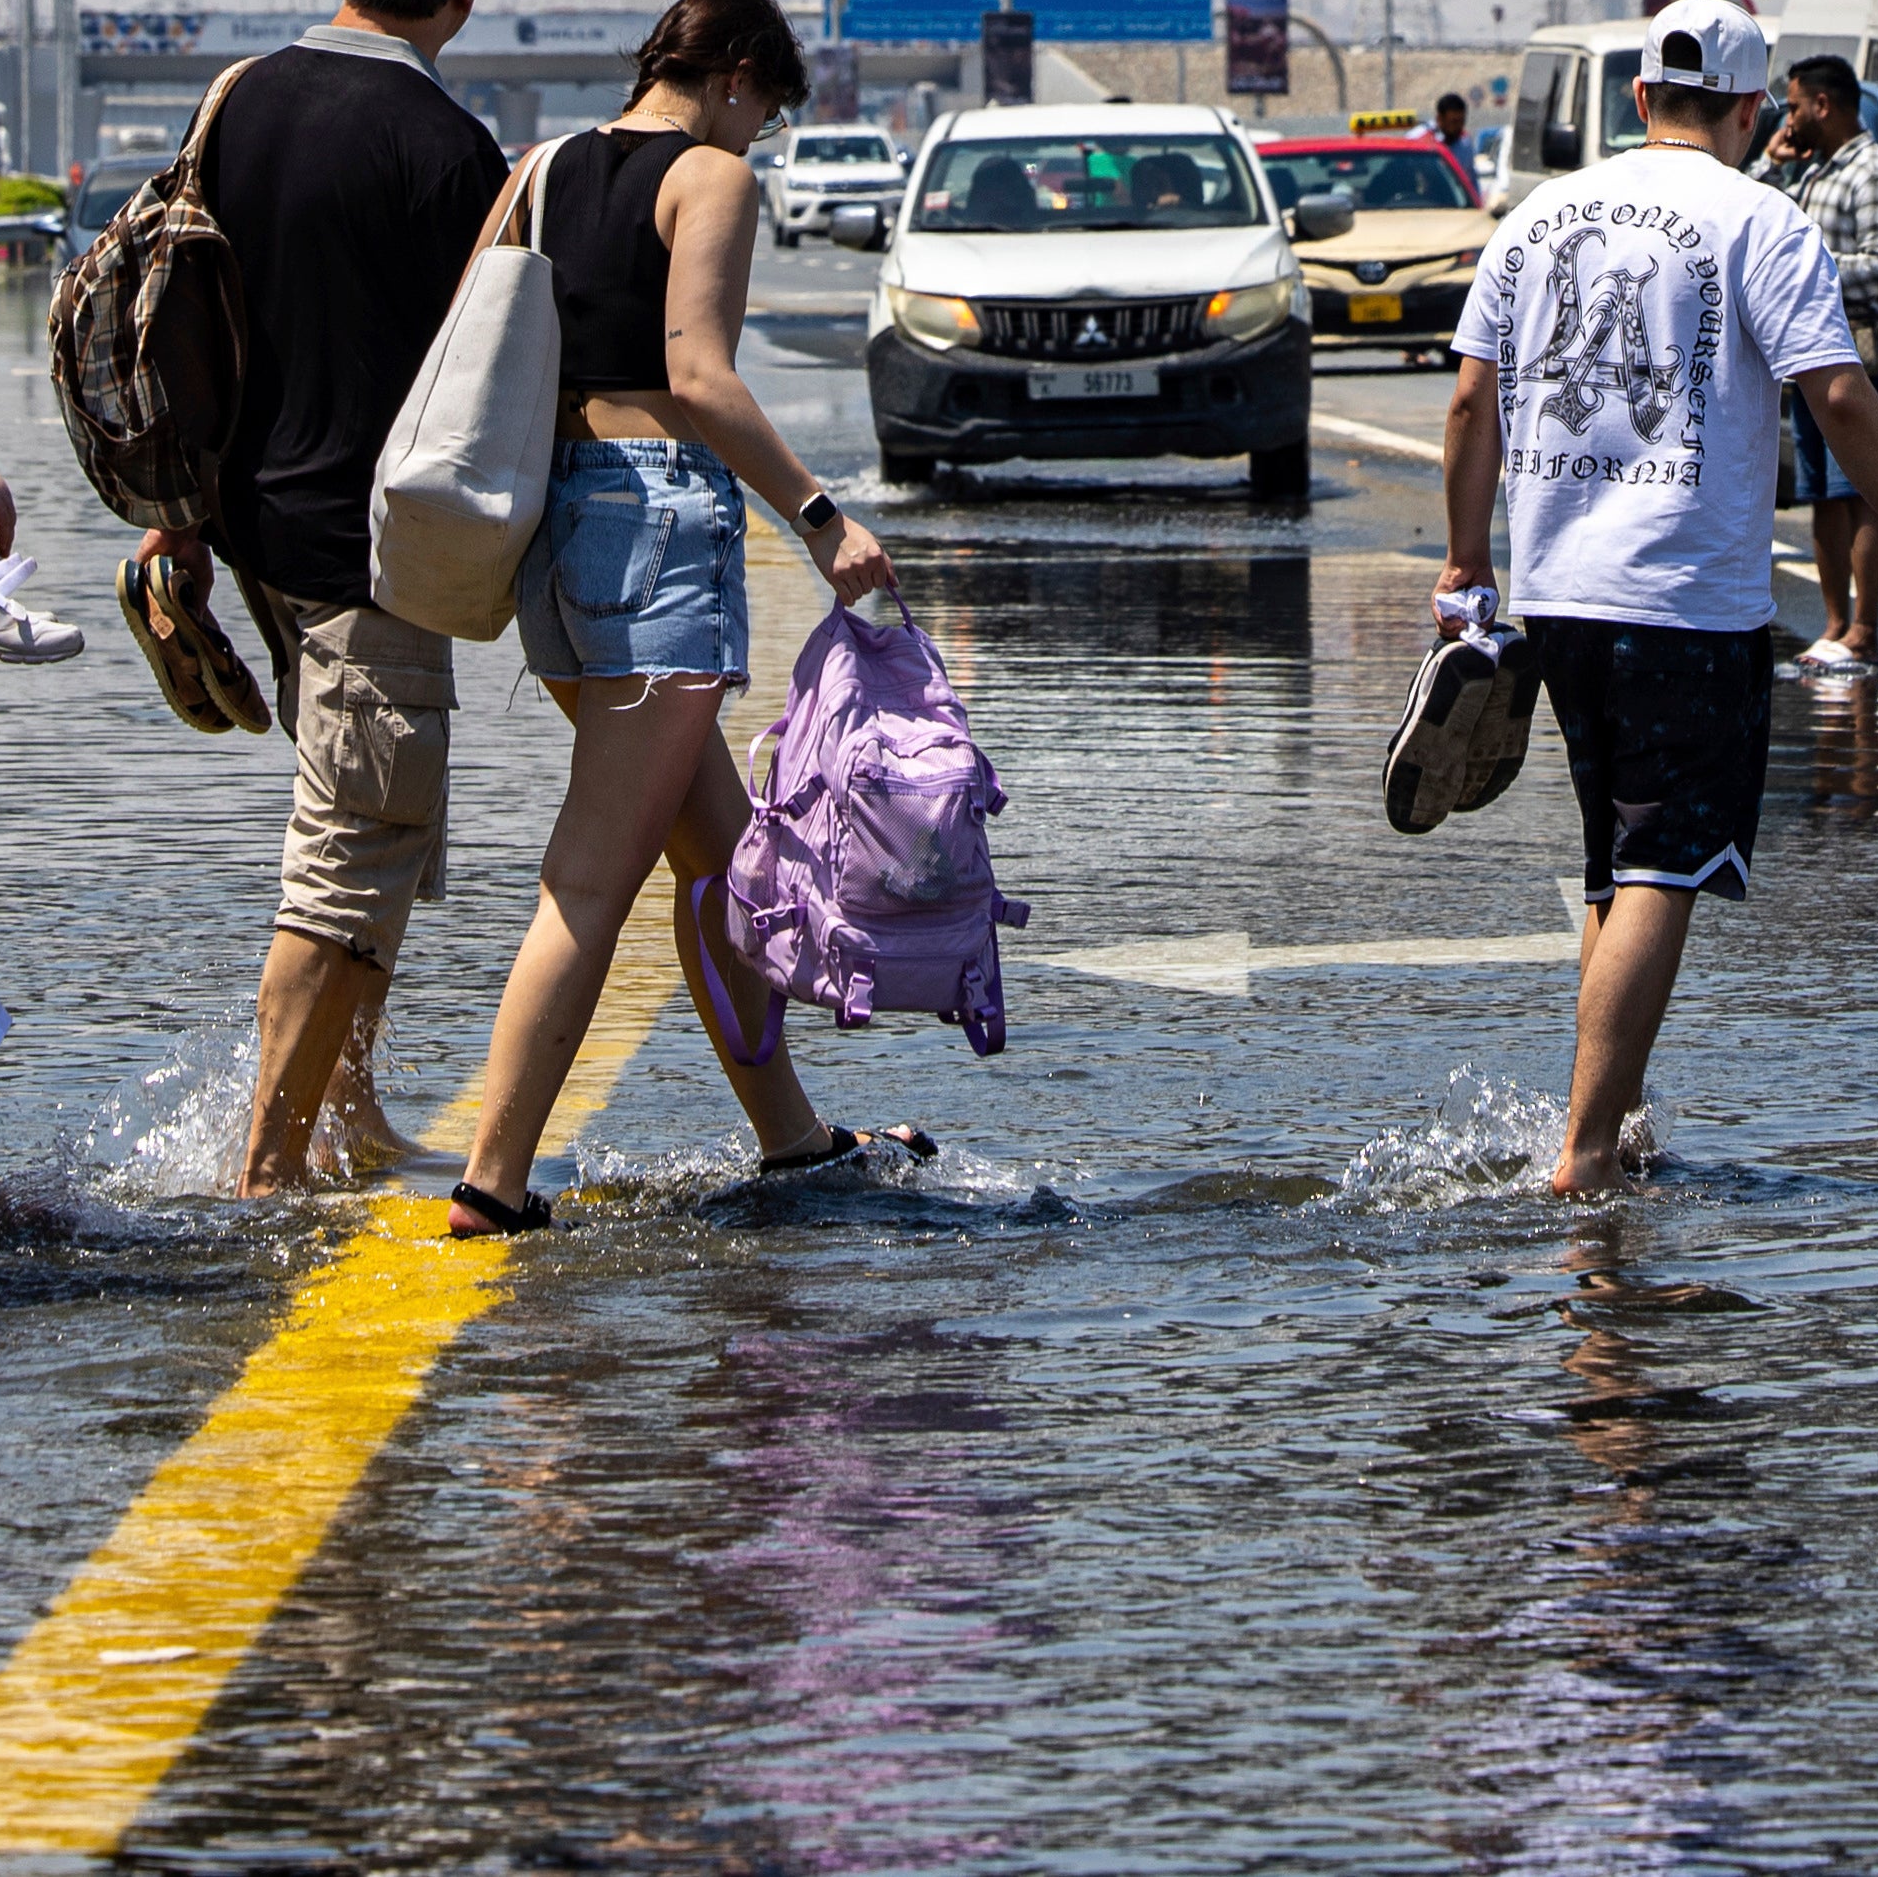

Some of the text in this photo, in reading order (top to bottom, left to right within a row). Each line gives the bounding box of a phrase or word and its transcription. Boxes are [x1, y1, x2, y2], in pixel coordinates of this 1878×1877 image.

[1528, 201, 1604, 244] ONE
[1611, 204, 1701, 253] ONLY
[1680, 254, 1724, 459] YOURSELF
